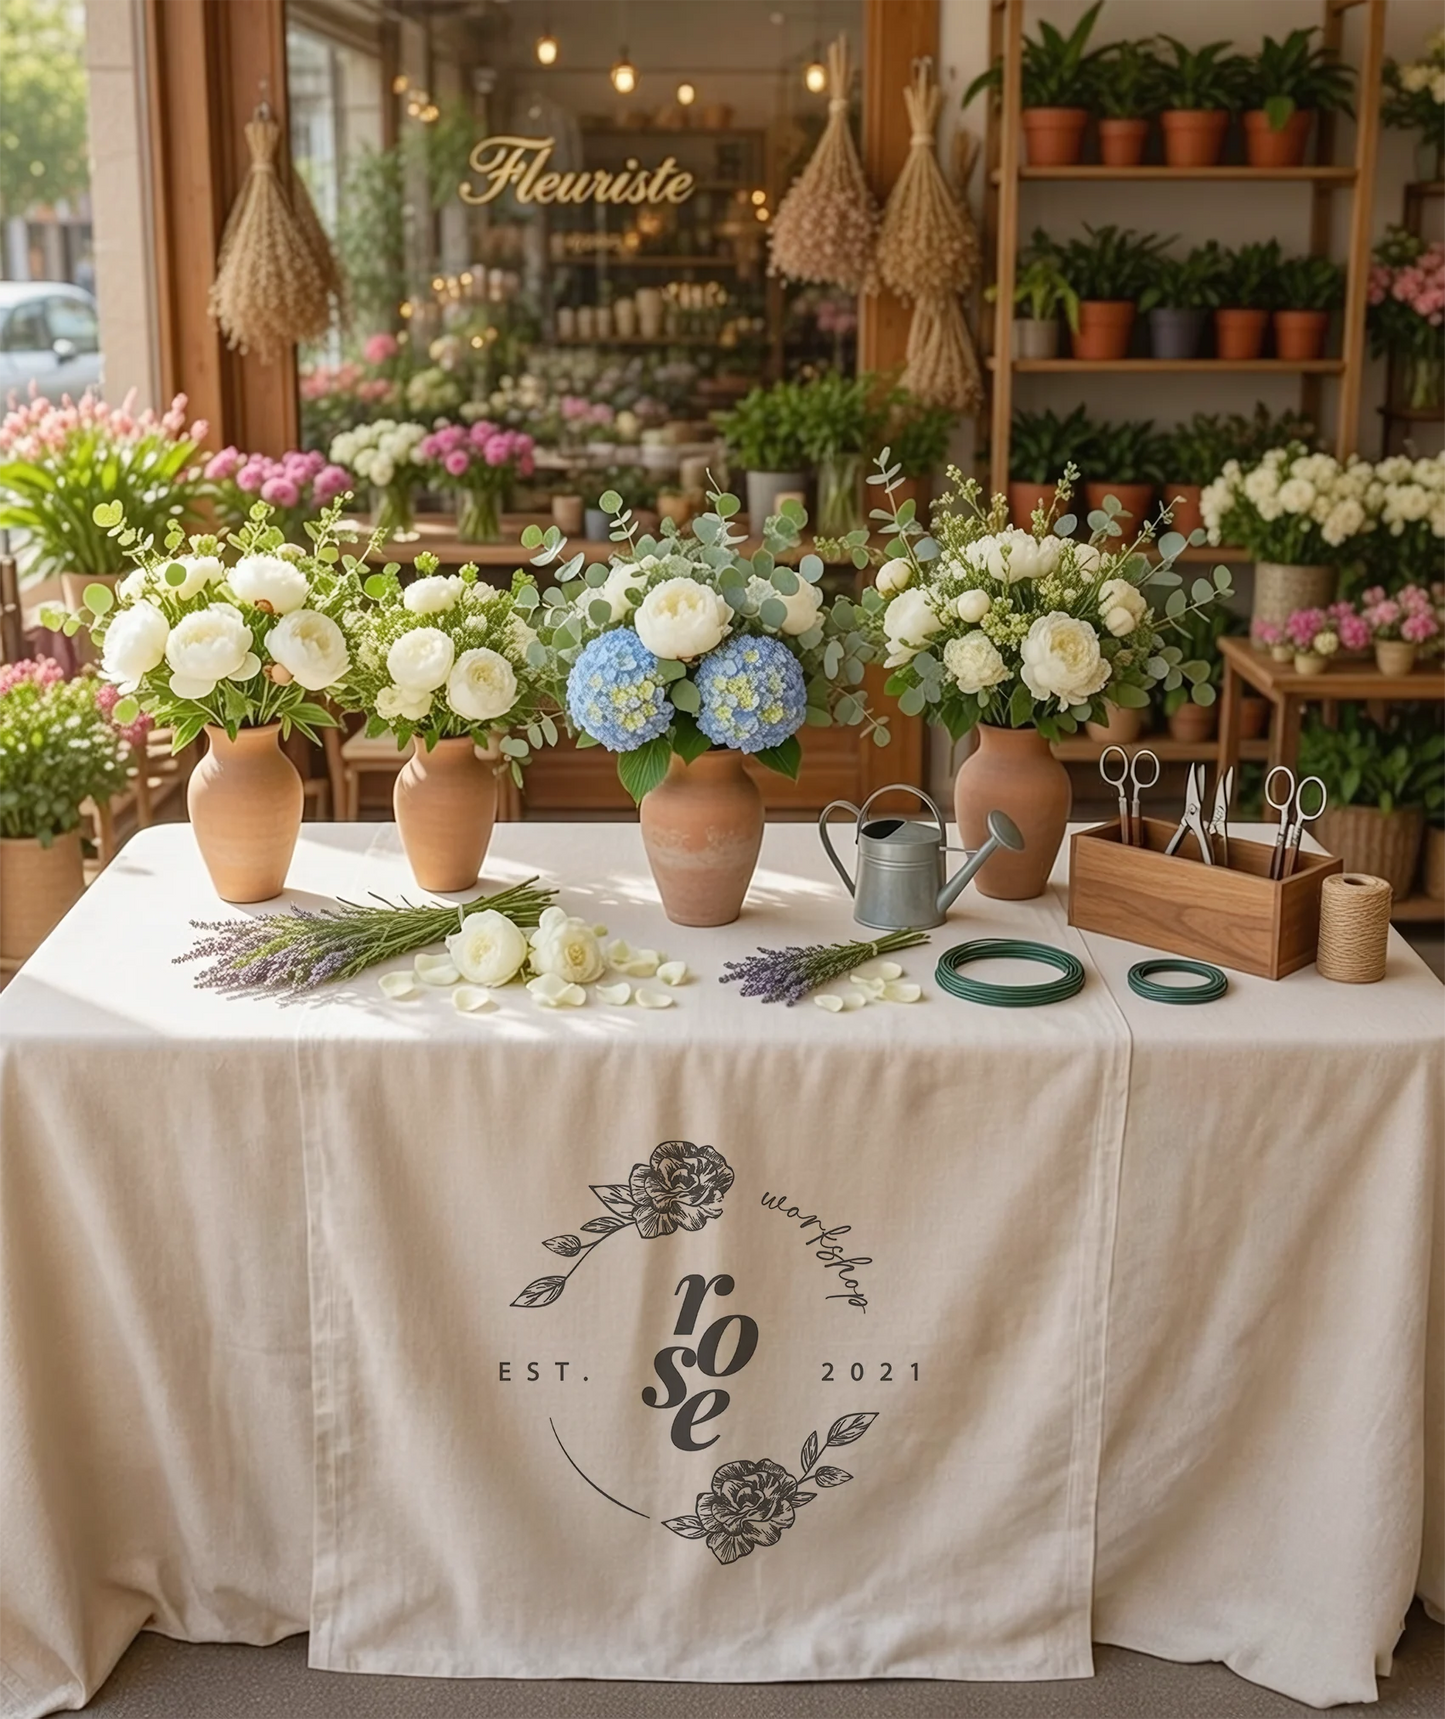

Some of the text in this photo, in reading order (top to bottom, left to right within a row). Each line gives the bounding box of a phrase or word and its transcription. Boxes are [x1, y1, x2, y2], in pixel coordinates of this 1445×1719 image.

[459, 136, 695, 204] Fleuriste
[761, 1191, 873, 1314] workshop
[499, 1362, 589, 1381] EST.
[642, 1274, 759, 1451] rose
[821, 1362, 919, 1381] 2021
